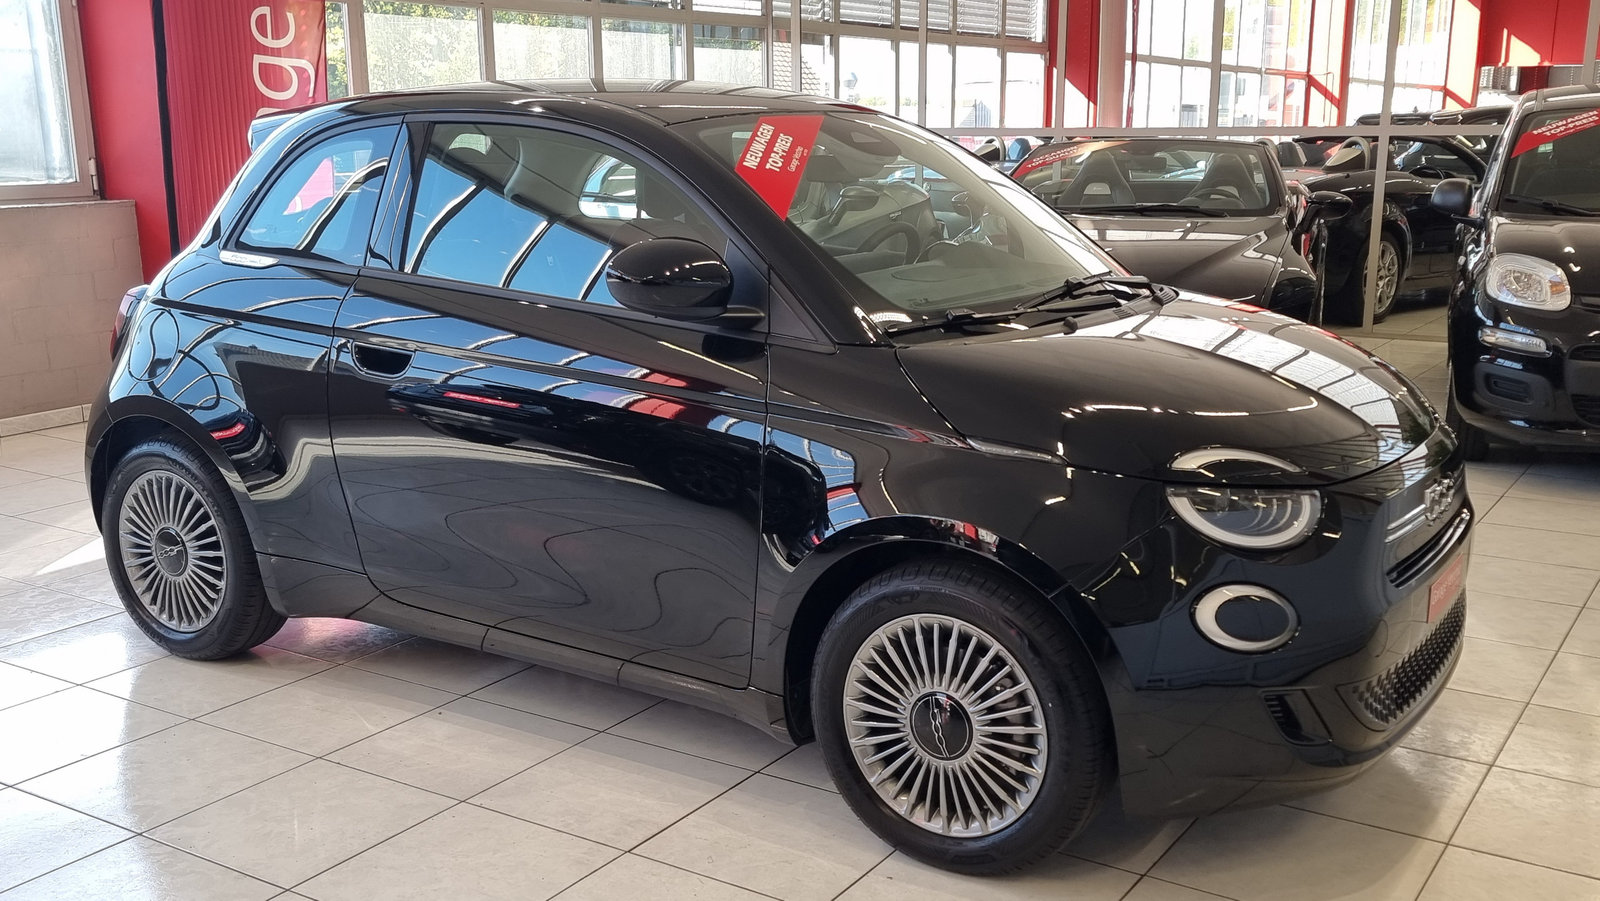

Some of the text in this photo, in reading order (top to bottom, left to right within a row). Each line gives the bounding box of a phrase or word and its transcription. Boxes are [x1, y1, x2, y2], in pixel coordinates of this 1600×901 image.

[1532, 110, 1599, 135] NEUWAGEN
[1543, 116, 1599, 136] TOP-PREIS
[743, 123, 775, 169] NEUWAGEN
[765, 133, 793, 172] TOP-PREIS
[1032, 145, 1078, 162] OCCASION
